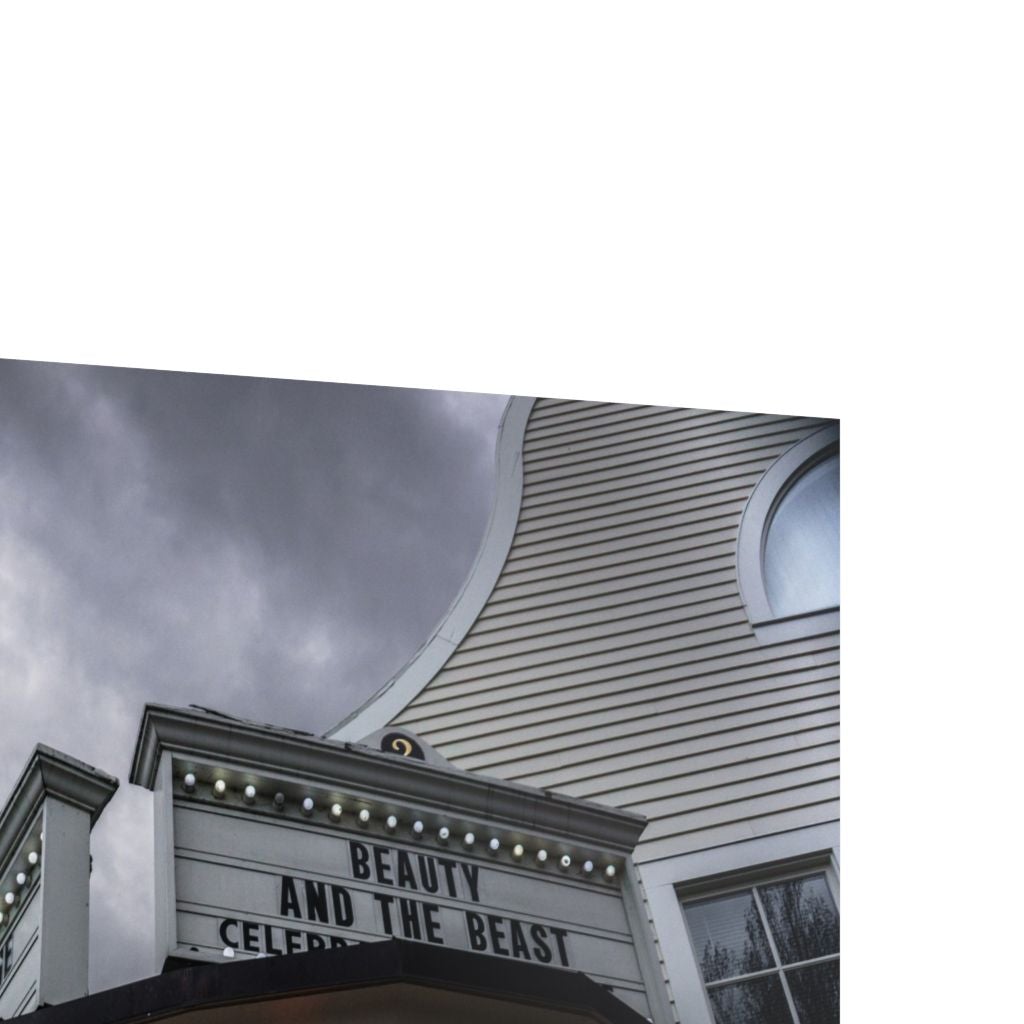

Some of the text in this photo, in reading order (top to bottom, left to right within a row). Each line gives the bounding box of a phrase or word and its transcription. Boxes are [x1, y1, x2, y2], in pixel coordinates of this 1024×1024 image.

[349, 842, 480, 902] BEAUTY
[280, 876, 570, 968] AND THE BEAST
